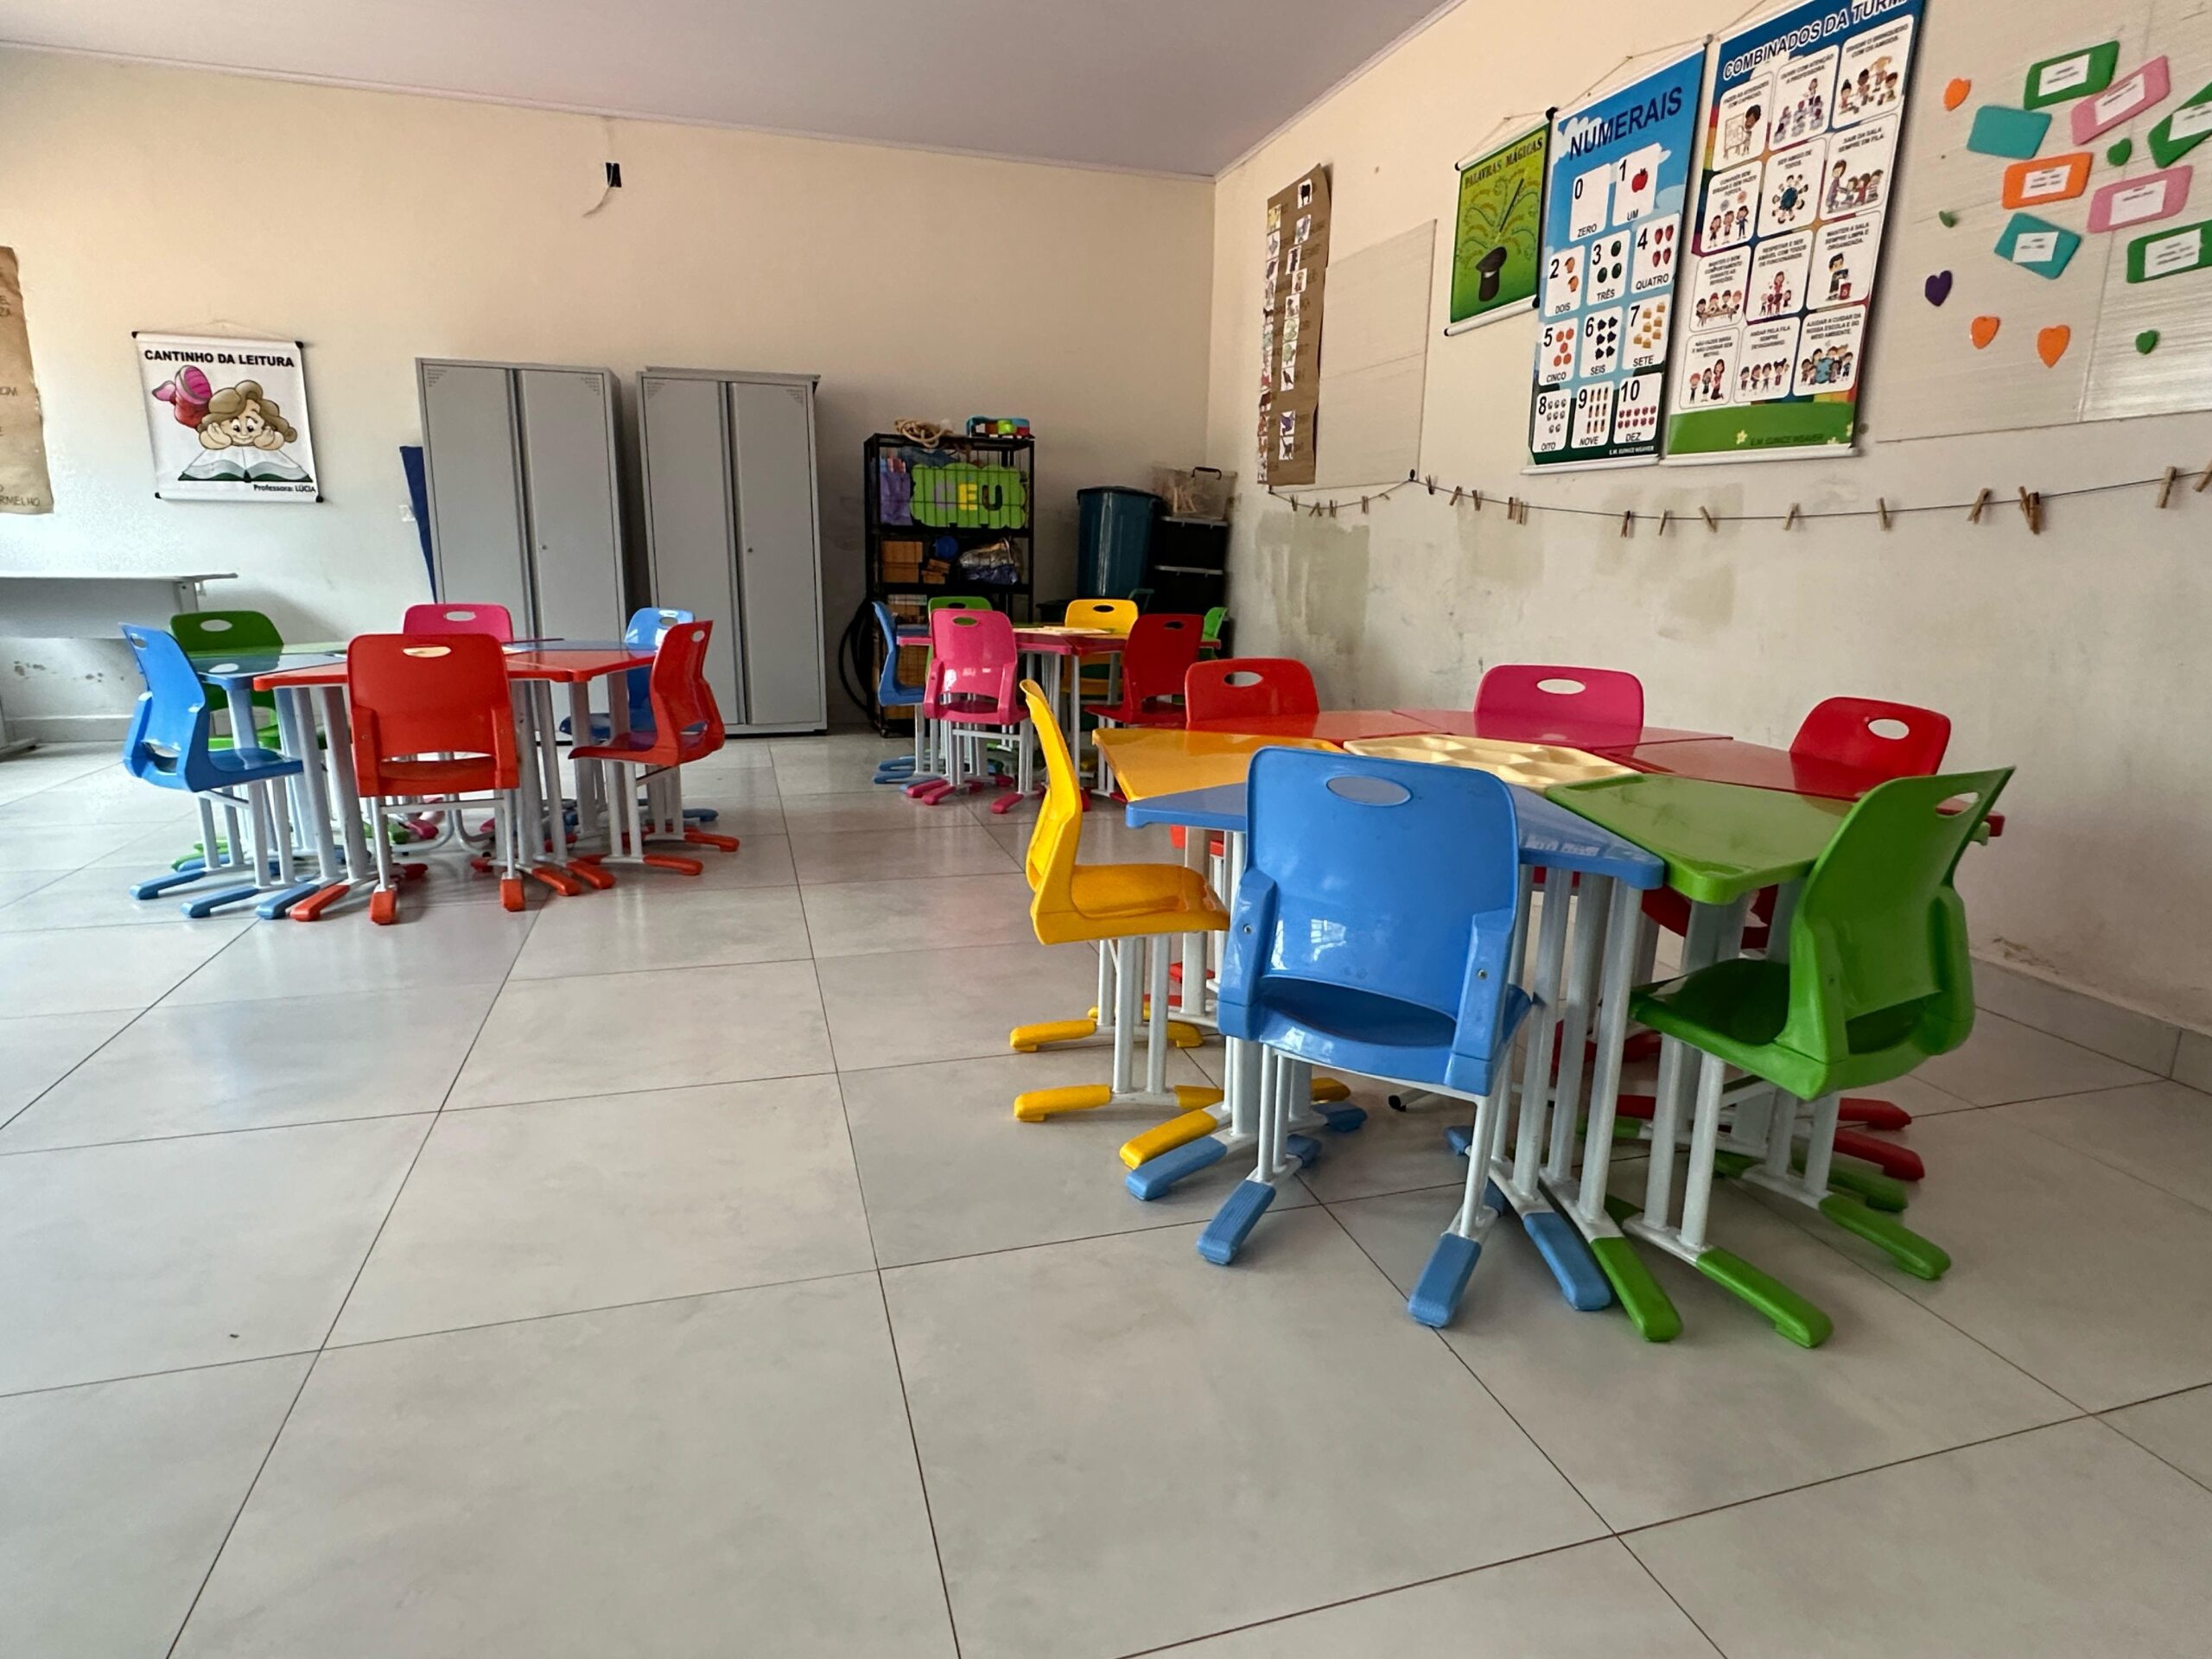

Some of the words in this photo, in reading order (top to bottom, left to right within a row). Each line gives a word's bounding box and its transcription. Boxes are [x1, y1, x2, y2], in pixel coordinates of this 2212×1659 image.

[1723, 20, 1821, 79] COMBINADOS
[1824, 10, 1848, 36] DA
[1569, 86, 1683, 161] NUMERAIS
[1465, 159, 1502, 189] PALAVRAS
[1506, 137, 1542, 167] MÁGICAS
[1619, 159, 1627, 181] 1
[1574, 178, 1583, 200] 0
[1627, 209, 1638, 221] UM
[1577, 223, 1597, 238] ZERO
[1637, 227, 1648, 251] 4
[1592, 244, 1602, 265] 3
[1549, 258, 1559, 279] 2
[1636, 273, 1669, 289] QUATRO
[1597, 289, 1615, 302] TRÊS
[1555, 302, 1571, 314] DOIS
[1630, 305, 1640, 327] 7
[1543, 327, 1554, 346] 5
[1586, 316, 1594, 338] 6
[144, 350, 213, 363] CANTINHO
[218, 353, 235, 364] DA
[238, 355, 295, 367] LEITURA
[1633, 355, 1654, 367] SETE
[1546, 372, 1567, 383] CINCO
[1590, 365, 1605, 376] SEIS
[1578, 388, 1587, 409] 9
[1620, 379, 1641, 403] 10
[1538, 396, 1547, 415] 8
[1541, 442, 1556, 451] OITO
[1580, 436, 1599, 446] NOVE
[1625, 432, 1642, 442] DEZ
[295, 484, 316, 493] LÚCIA
